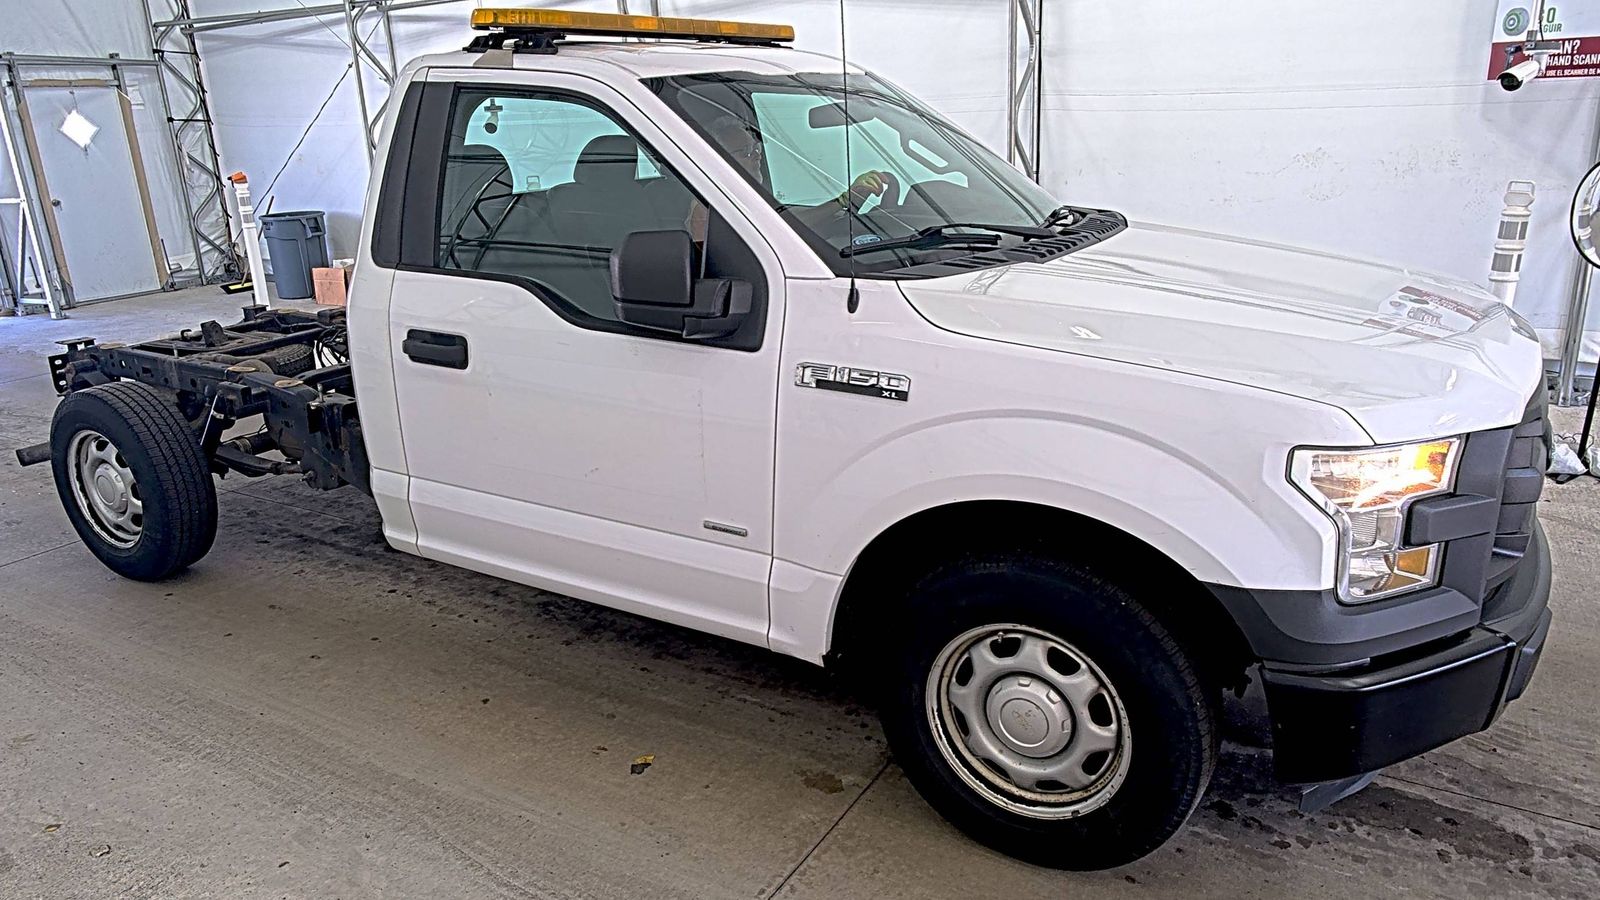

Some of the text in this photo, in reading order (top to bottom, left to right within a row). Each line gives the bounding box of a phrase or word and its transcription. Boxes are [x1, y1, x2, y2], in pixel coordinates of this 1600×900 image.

[1542, 23, 1562, 33] GUIR
[1547, 55, 1572, 66] HAND
[882, 390, 898, 399] XL
